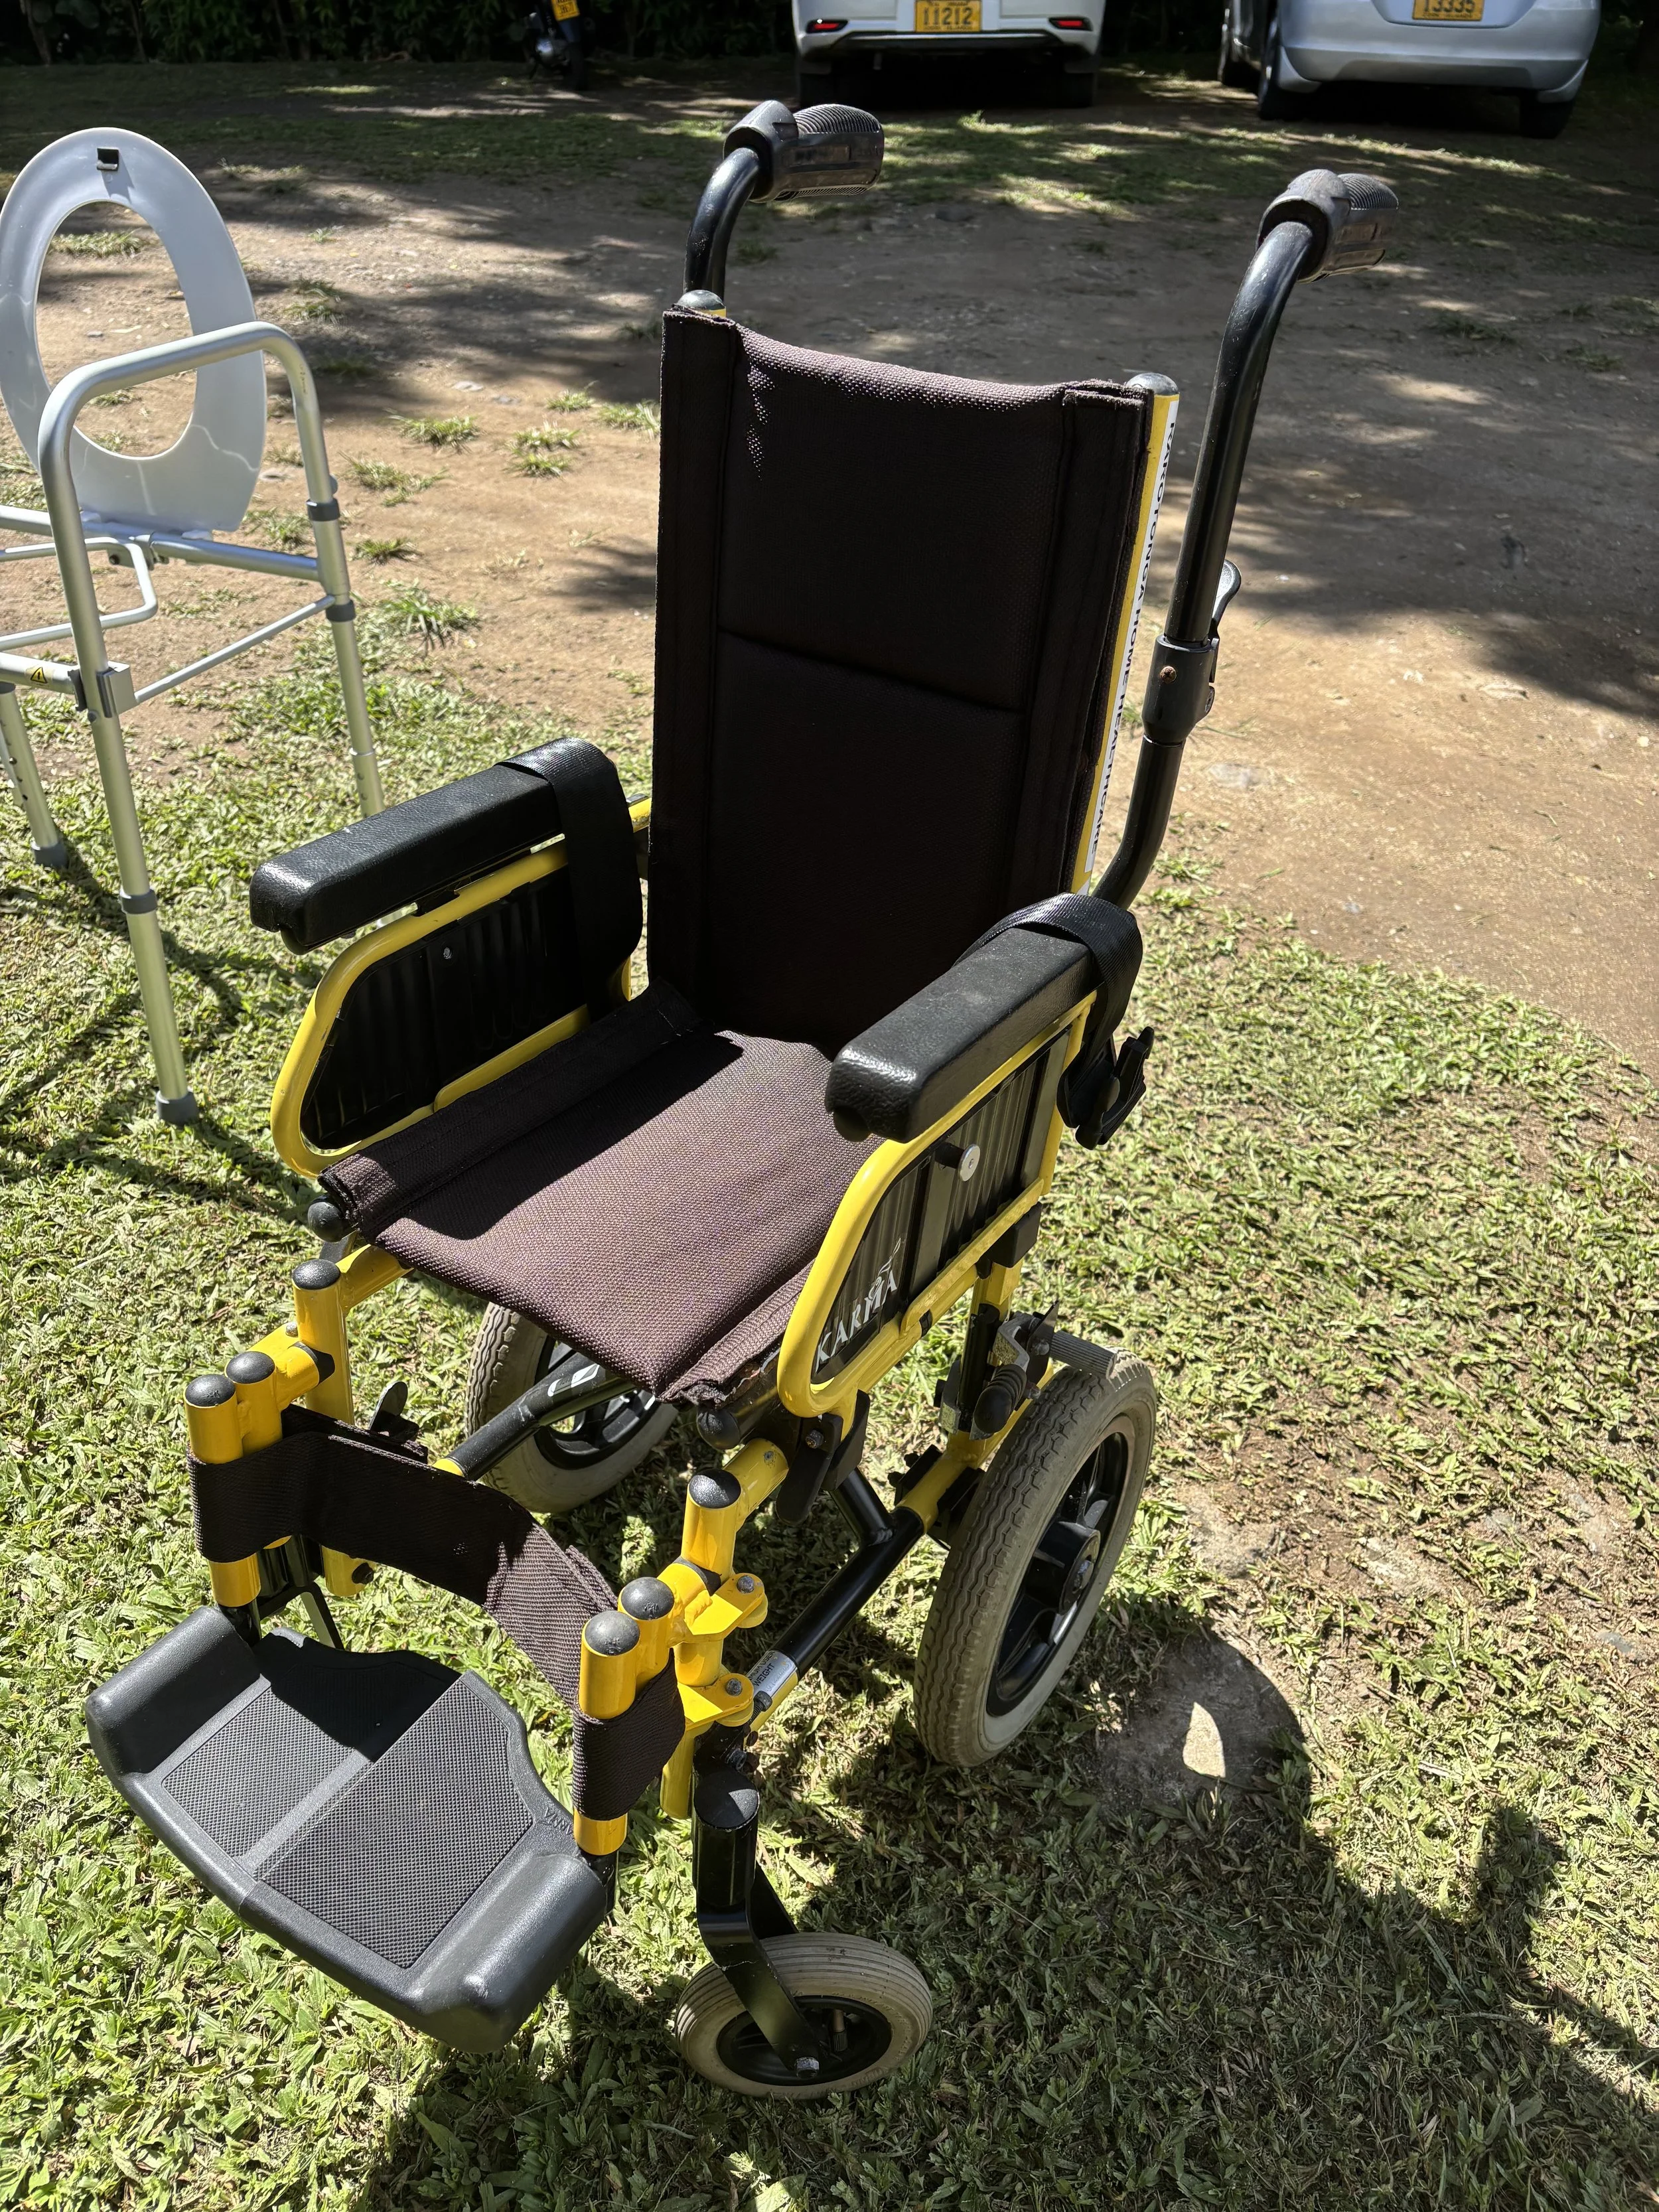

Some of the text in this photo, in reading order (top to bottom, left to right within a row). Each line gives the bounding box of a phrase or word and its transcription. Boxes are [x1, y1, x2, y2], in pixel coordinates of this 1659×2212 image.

[923, 7, 972, 25] 11212
[1122, 609, 1140, 686] HOME
[1092, 694, 1126, 855] HEALTHCARE
[816, 1256, 898, 1372] KARMA
[753, 1663, 776, 1686] WEIGHT
